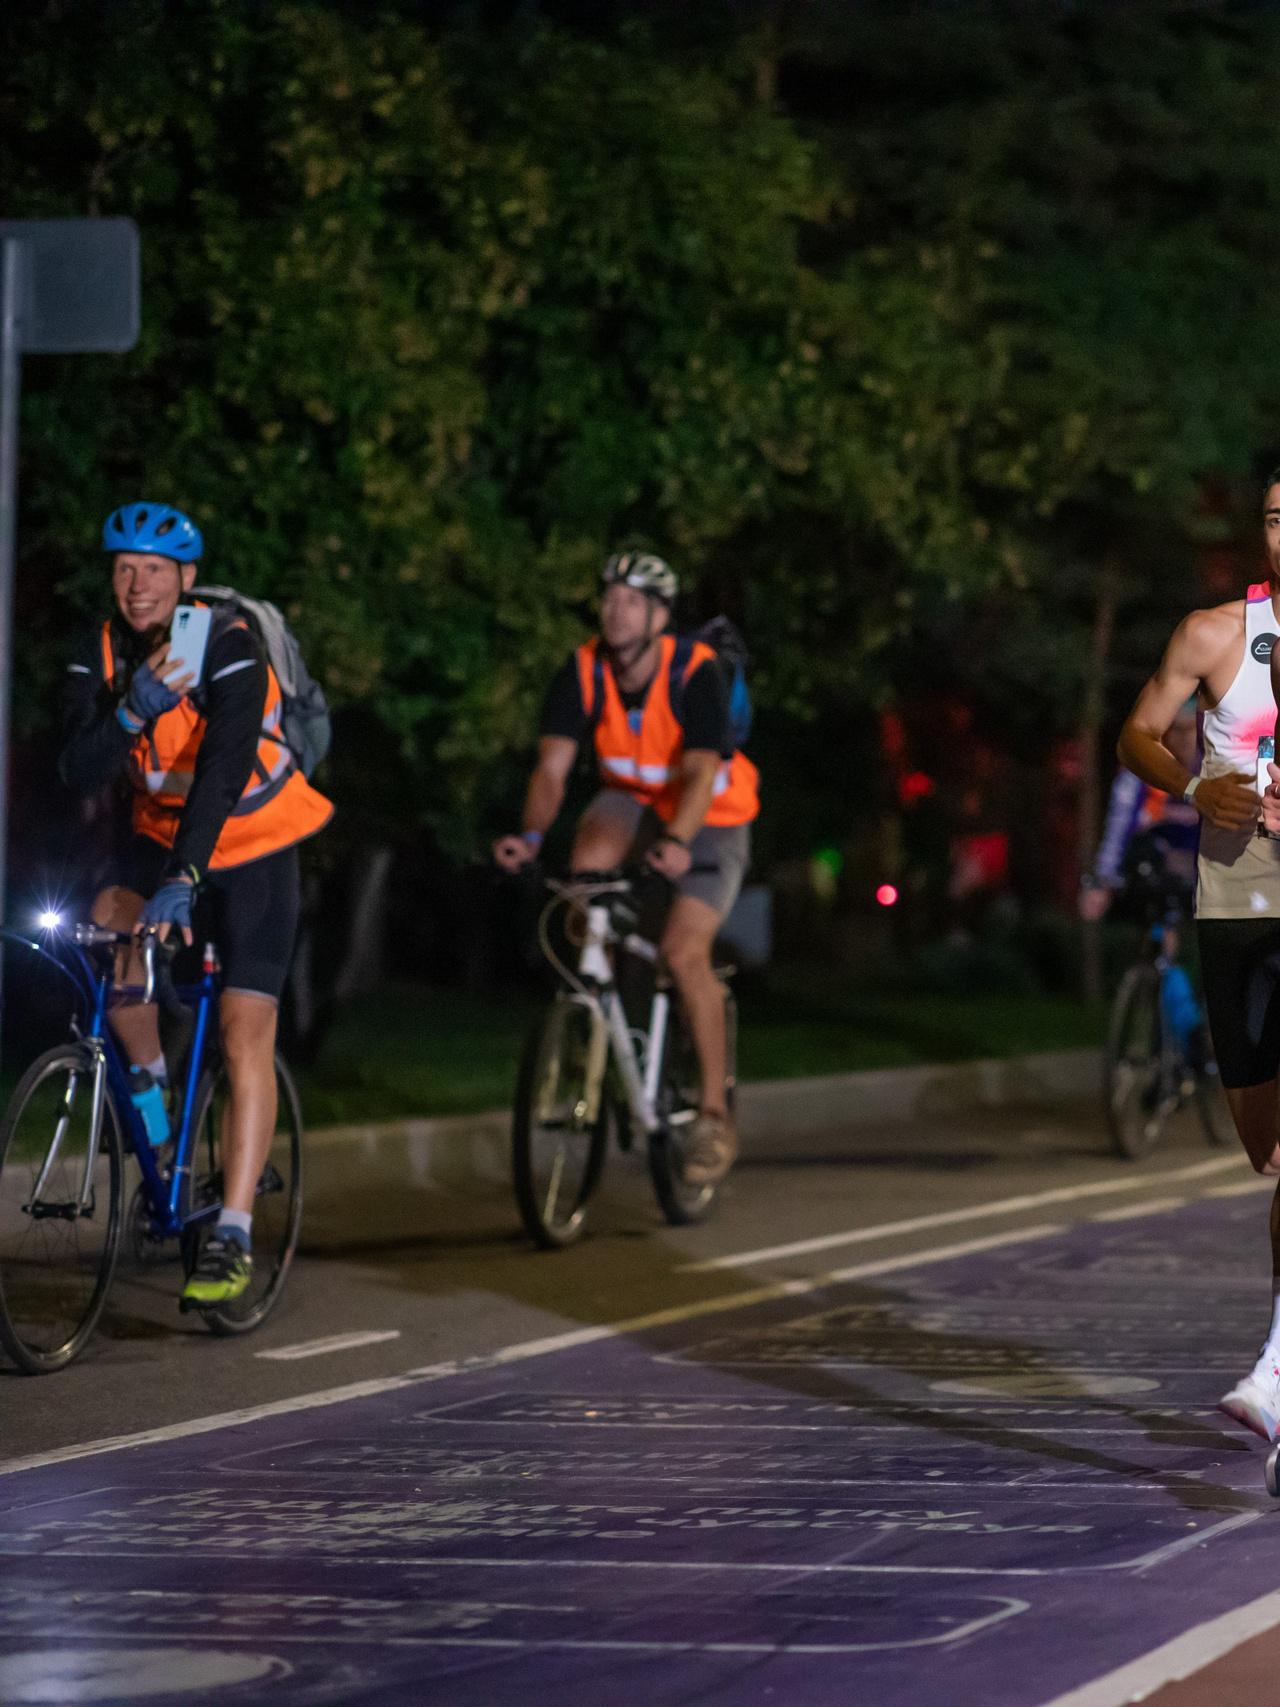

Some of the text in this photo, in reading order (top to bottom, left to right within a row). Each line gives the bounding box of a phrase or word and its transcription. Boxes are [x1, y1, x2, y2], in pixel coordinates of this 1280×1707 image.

[806, 1405, 1220, 1416] поменяйт
[683, 1507, 984, 1520] пятку
[636, 1518, 1094, 1534] чувствуя
